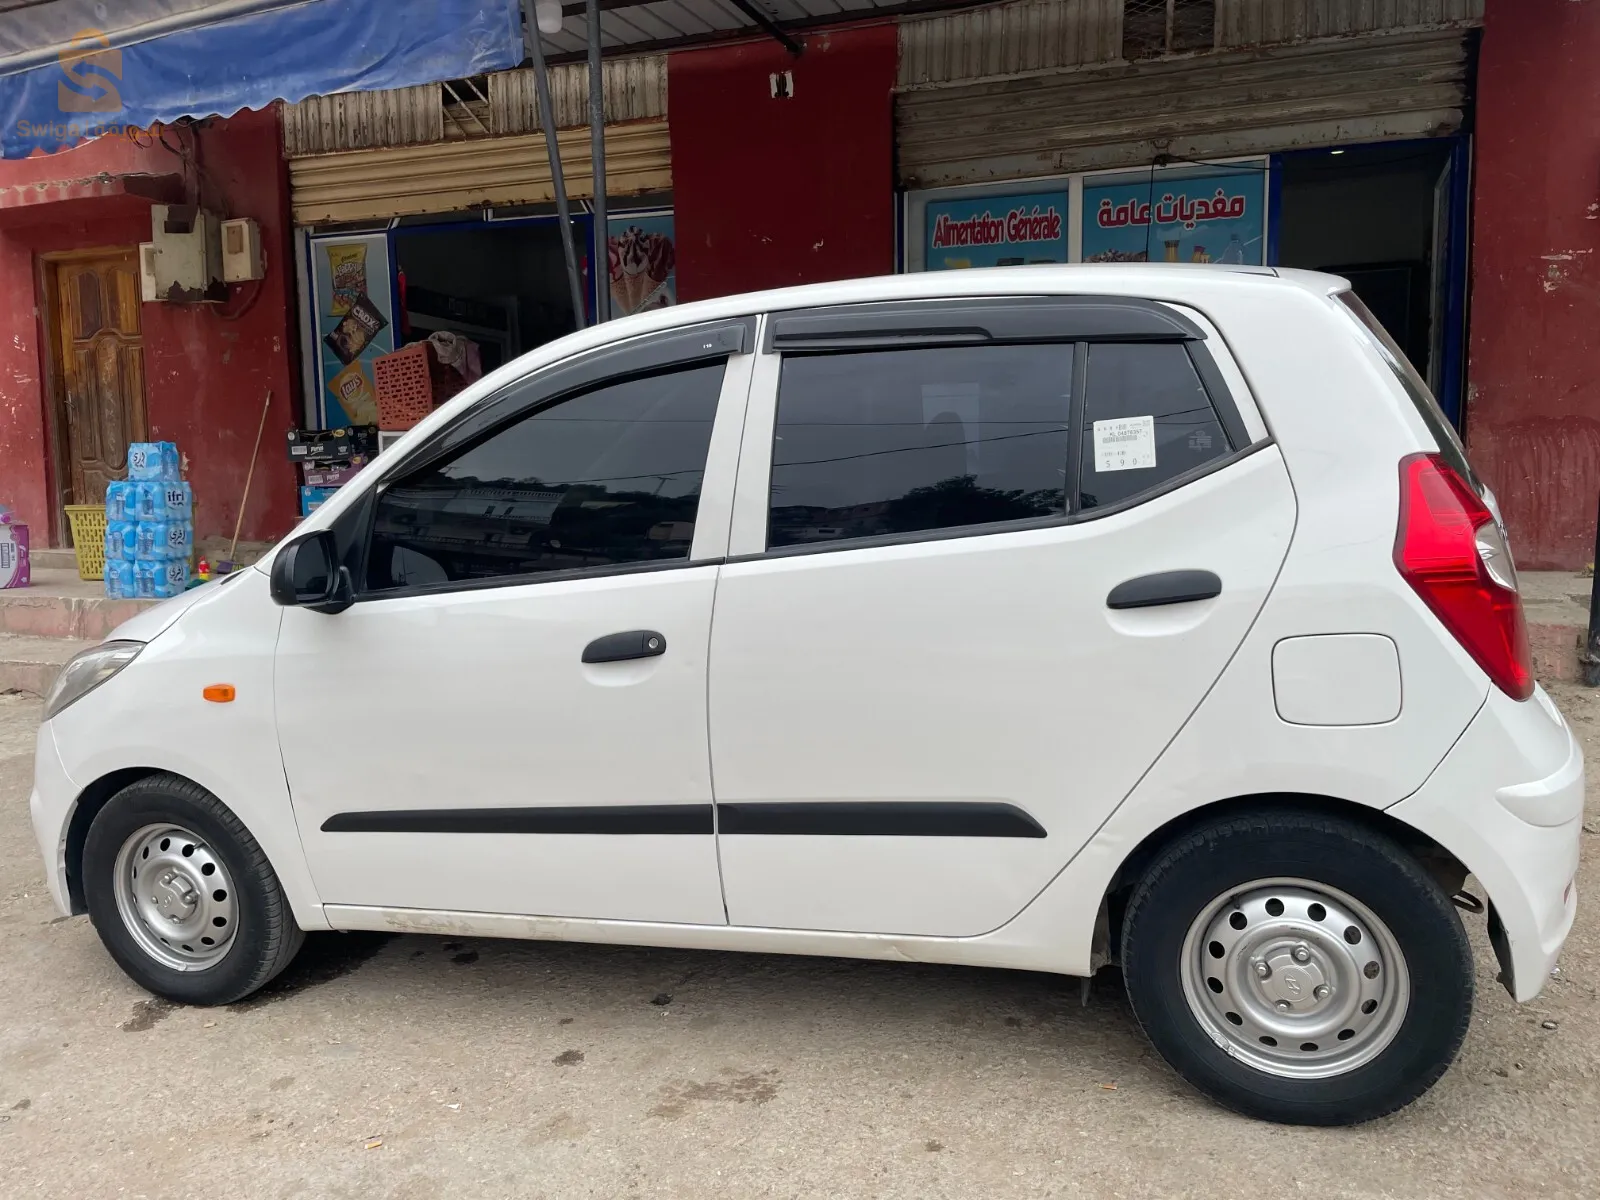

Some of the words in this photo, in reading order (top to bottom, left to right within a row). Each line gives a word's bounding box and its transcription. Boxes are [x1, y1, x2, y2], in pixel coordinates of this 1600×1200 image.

[932, 211, 1005, 249] Alimentation
[1006, 205, 1061, 244] Générale
[1097, 198, 1152, 229] عامة
[167, 490, 184, 502] ifri
